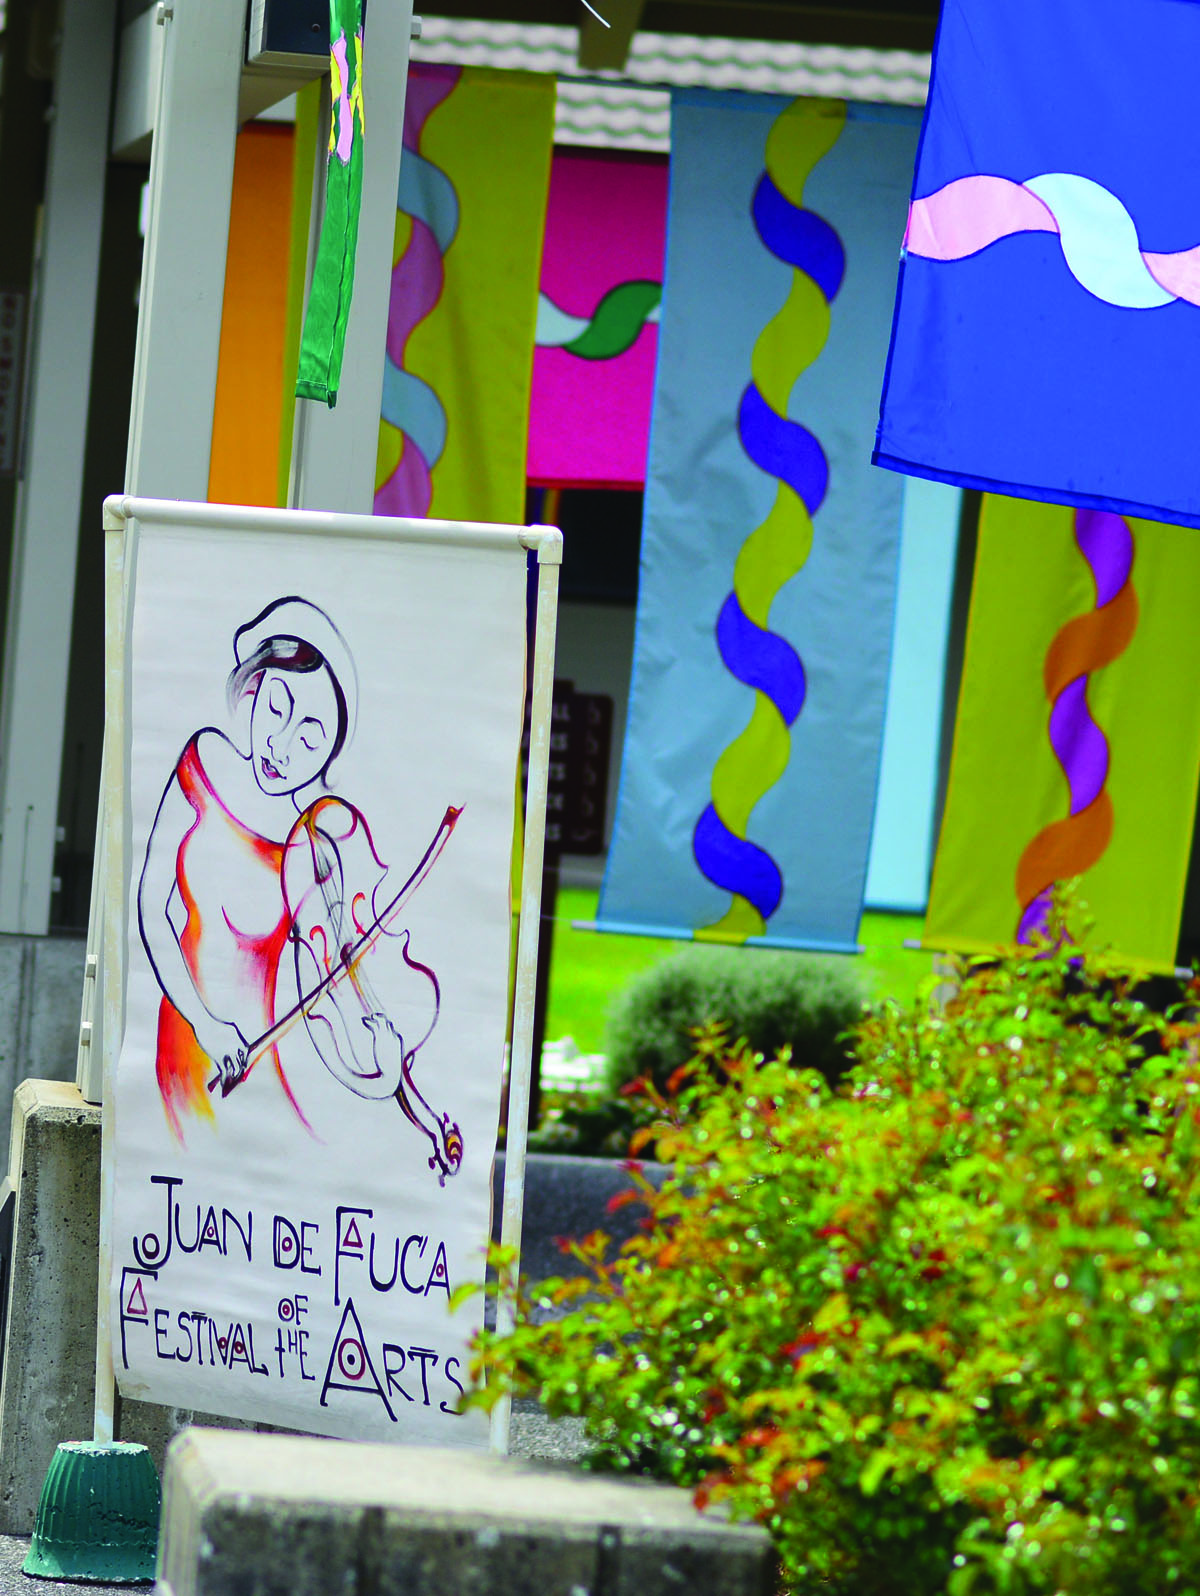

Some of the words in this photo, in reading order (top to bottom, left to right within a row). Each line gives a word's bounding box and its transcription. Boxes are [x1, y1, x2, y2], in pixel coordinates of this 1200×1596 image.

[133, 1175, 253, 1270] JUAN
[273, 1215, 322, 1277] DE
[119, 1266, 269, 1376] FESTIVAL
[278, 1294, 309, 1326] OF
[319, 1296, 464, 1423] ARTS
